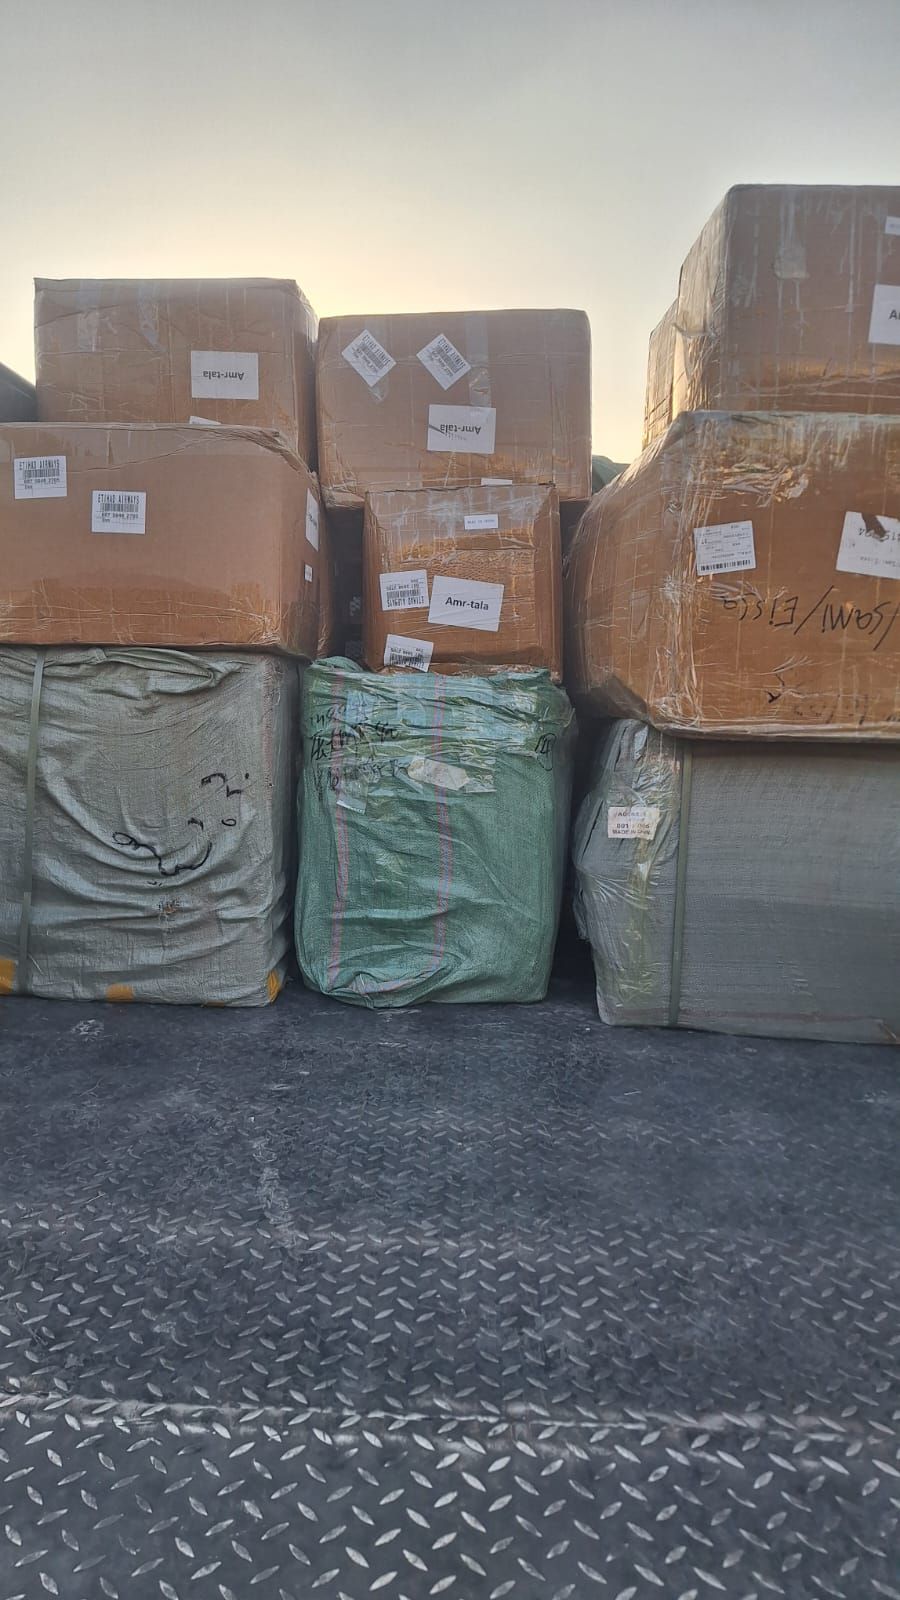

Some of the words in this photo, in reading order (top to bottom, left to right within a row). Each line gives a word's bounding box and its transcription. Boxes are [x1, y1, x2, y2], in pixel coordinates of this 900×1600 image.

[202, 370, 245, 381] Amr-tala
[440, 424, 482, 435] Amr-tala
[97, 493, 116, 503] ETIHAD
[118, 495, 140, 504] AIRWAYS
[445, 597, 489, 611] Amr-tala
